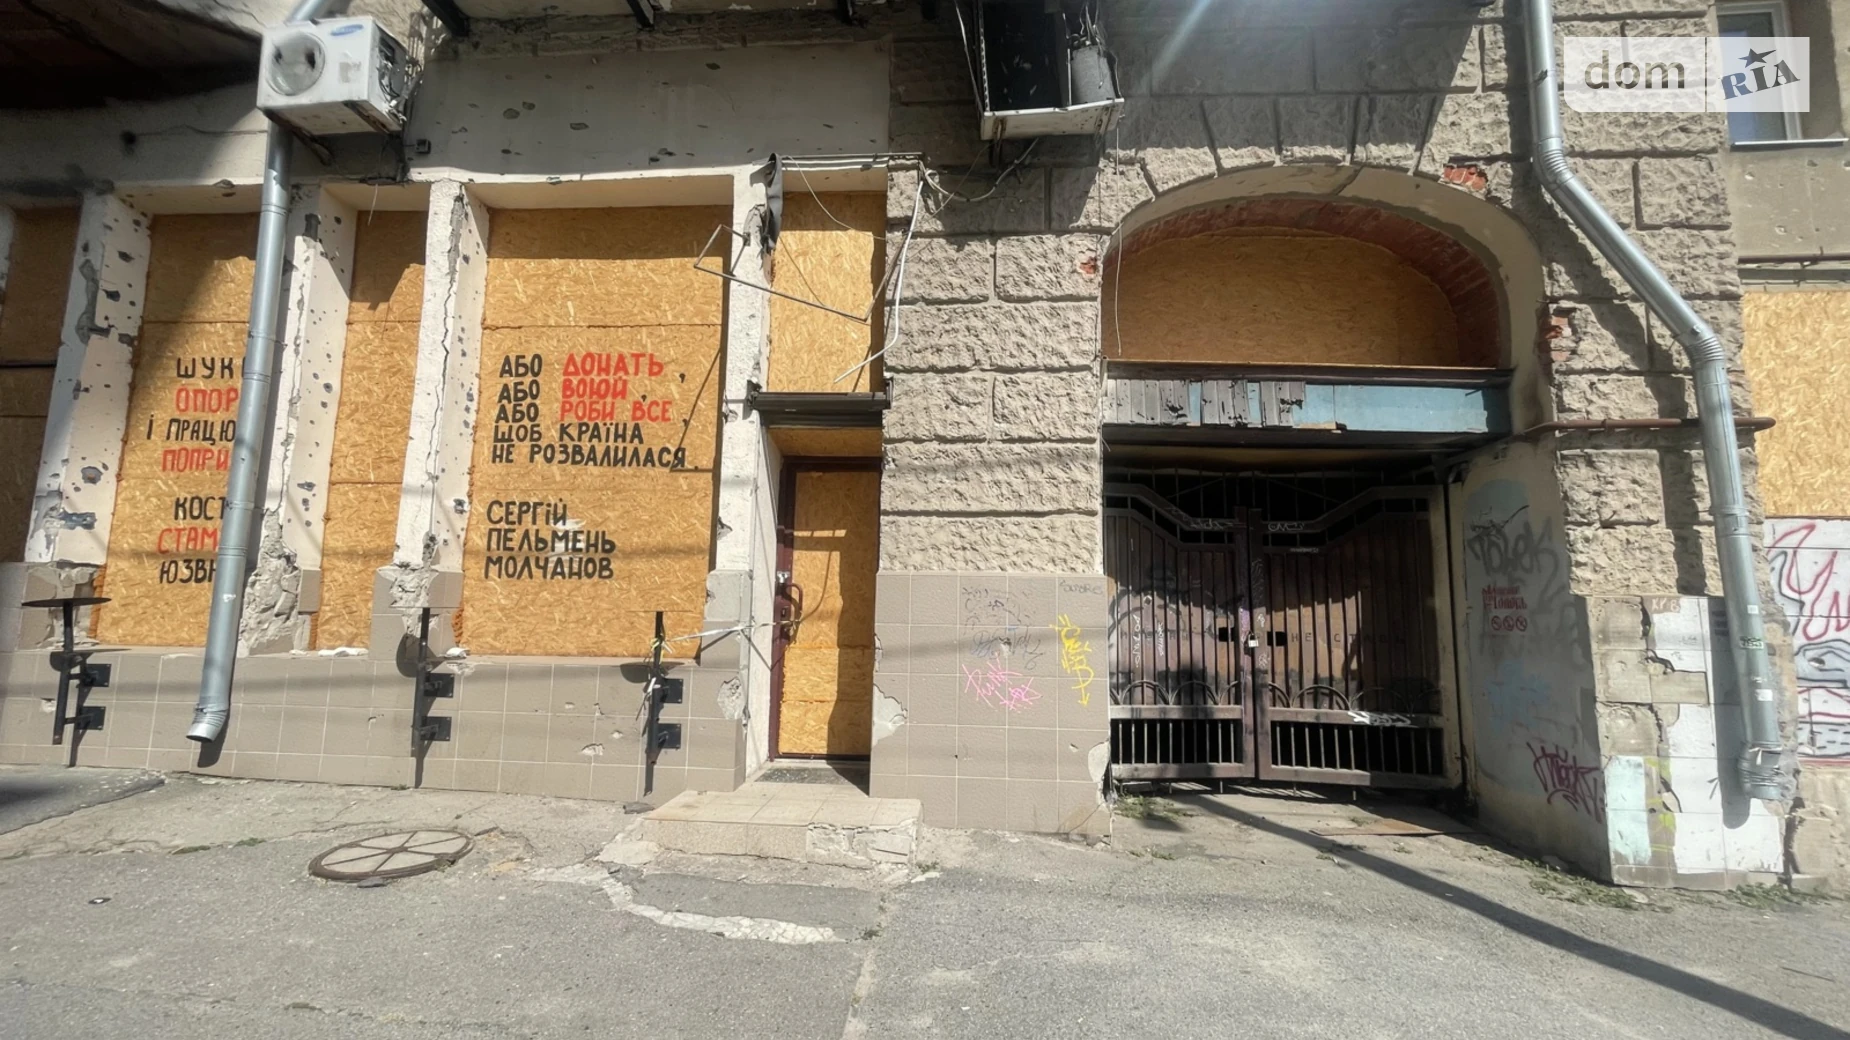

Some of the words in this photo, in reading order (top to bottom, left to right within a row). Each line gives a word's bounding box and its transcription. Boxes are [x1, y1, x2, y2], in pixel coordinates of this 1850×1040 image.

[176, 357, 247, 379] ШУК
[500, 353, 543, 378] АБО
[175, 387, 239, 413] ОПОР
[498, 380, 540, 403] АБО
[494, 402, 539, 424] АБО
[559, 400, 616, 422] РОБИ
[166, 418, 236, 445] ПРАЦЮ
[559, 422, 644, 445] КРАЇНА
[491, 443, 515, 465] НЕ
[157, 527, 219, 555] СТАМ
[486, 528, 617, 555] ПЕЛЬМЕНЬ
[484, 556, 614, 581] МОЛЧАНОВ
